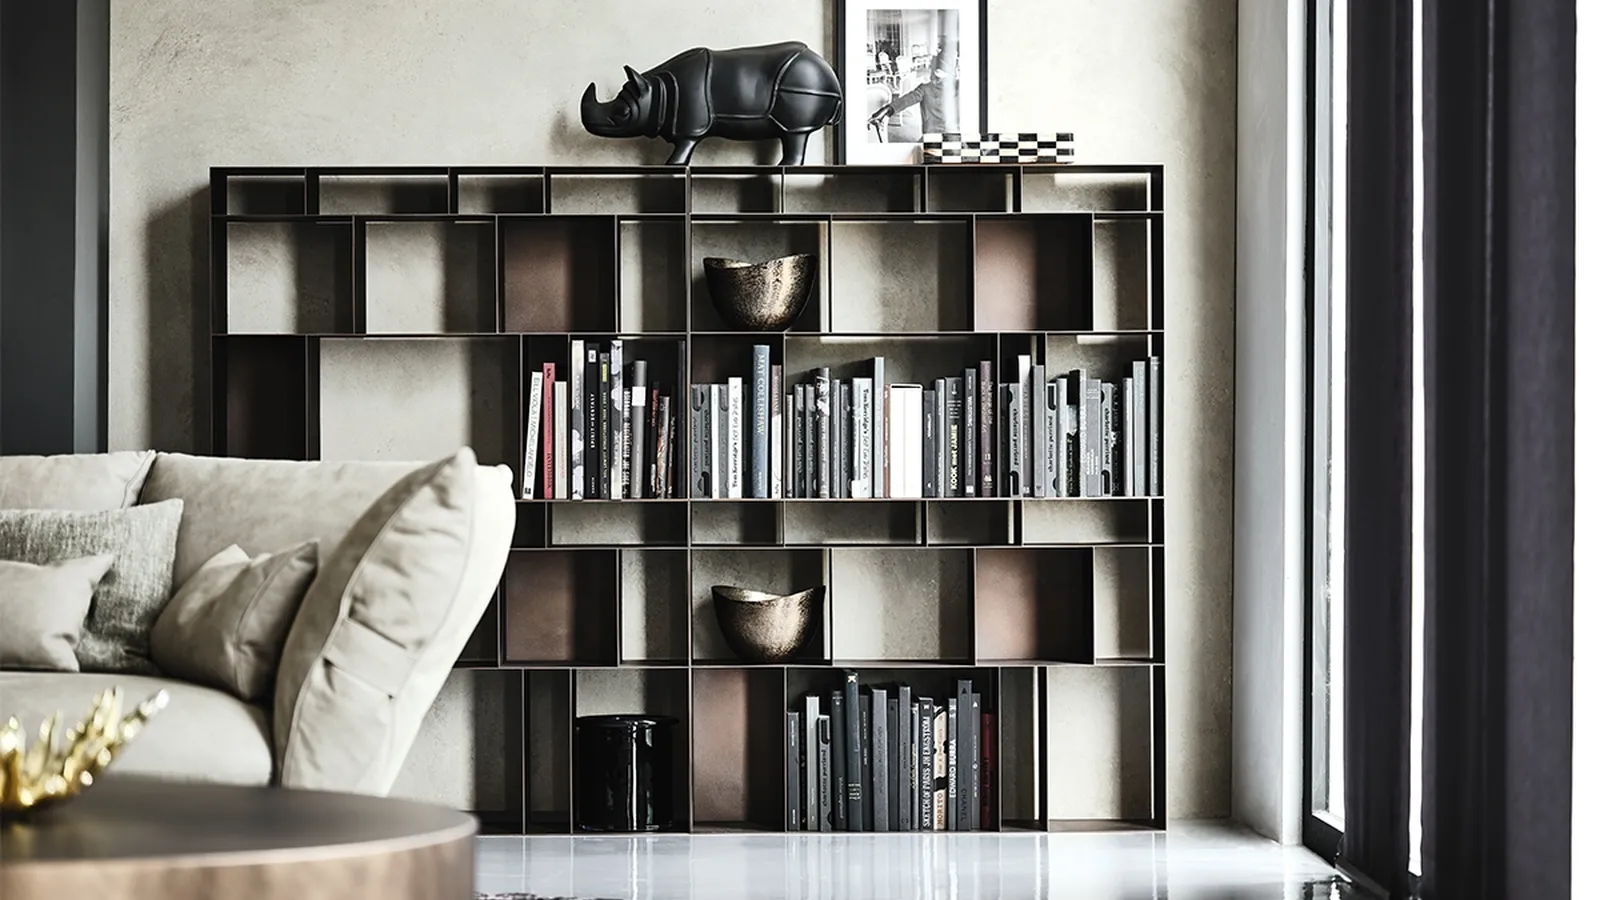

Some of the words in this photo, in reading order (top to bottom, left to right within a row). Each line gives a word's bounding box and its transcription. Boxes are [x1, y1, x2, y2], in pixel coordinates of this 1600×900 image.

[757, 377, 765, 435] COLLISHAW
[950, 424, 958, 449] JAMIE
[950, 466, 958, 490] KOOK
[948, 739, 957, 765] BURRA
[948, 767, 957, 798] EDWARD
[922, 799, 931, 827] SKETCH
[960, 788, 968, 822] CHANEL
